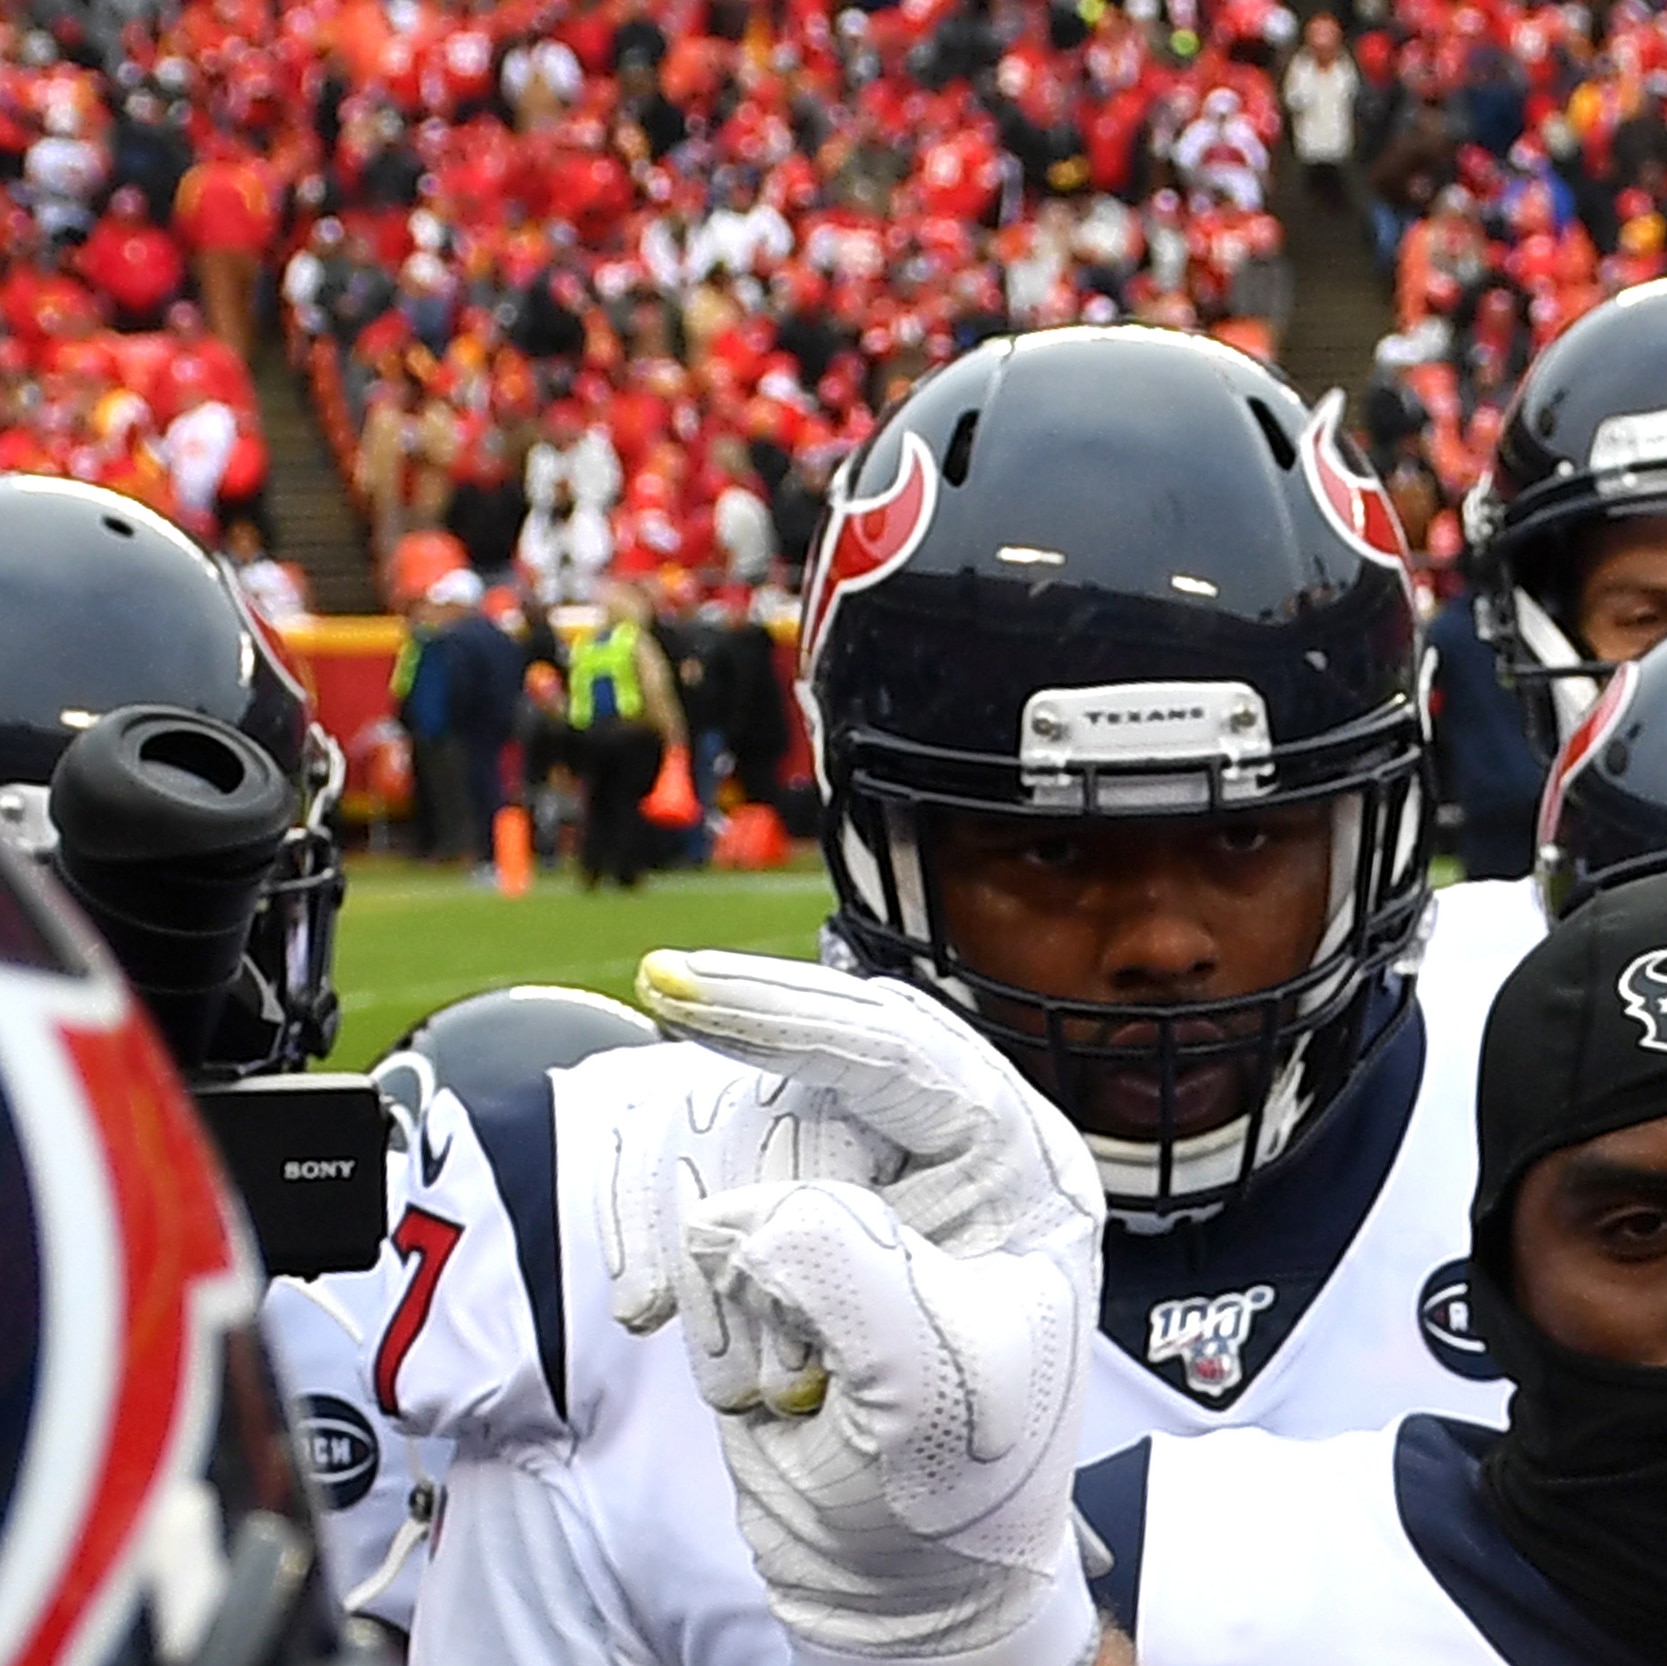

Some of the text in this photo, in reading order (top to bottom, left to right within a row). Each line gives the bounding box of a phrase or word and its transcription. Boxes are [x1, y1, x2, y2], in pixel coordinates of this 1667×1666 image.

[1083, 707, 1204, 726] TEXANS
[284, 1159, 356, 1180] SONY
[373, 1202, 466, 1417] 7
